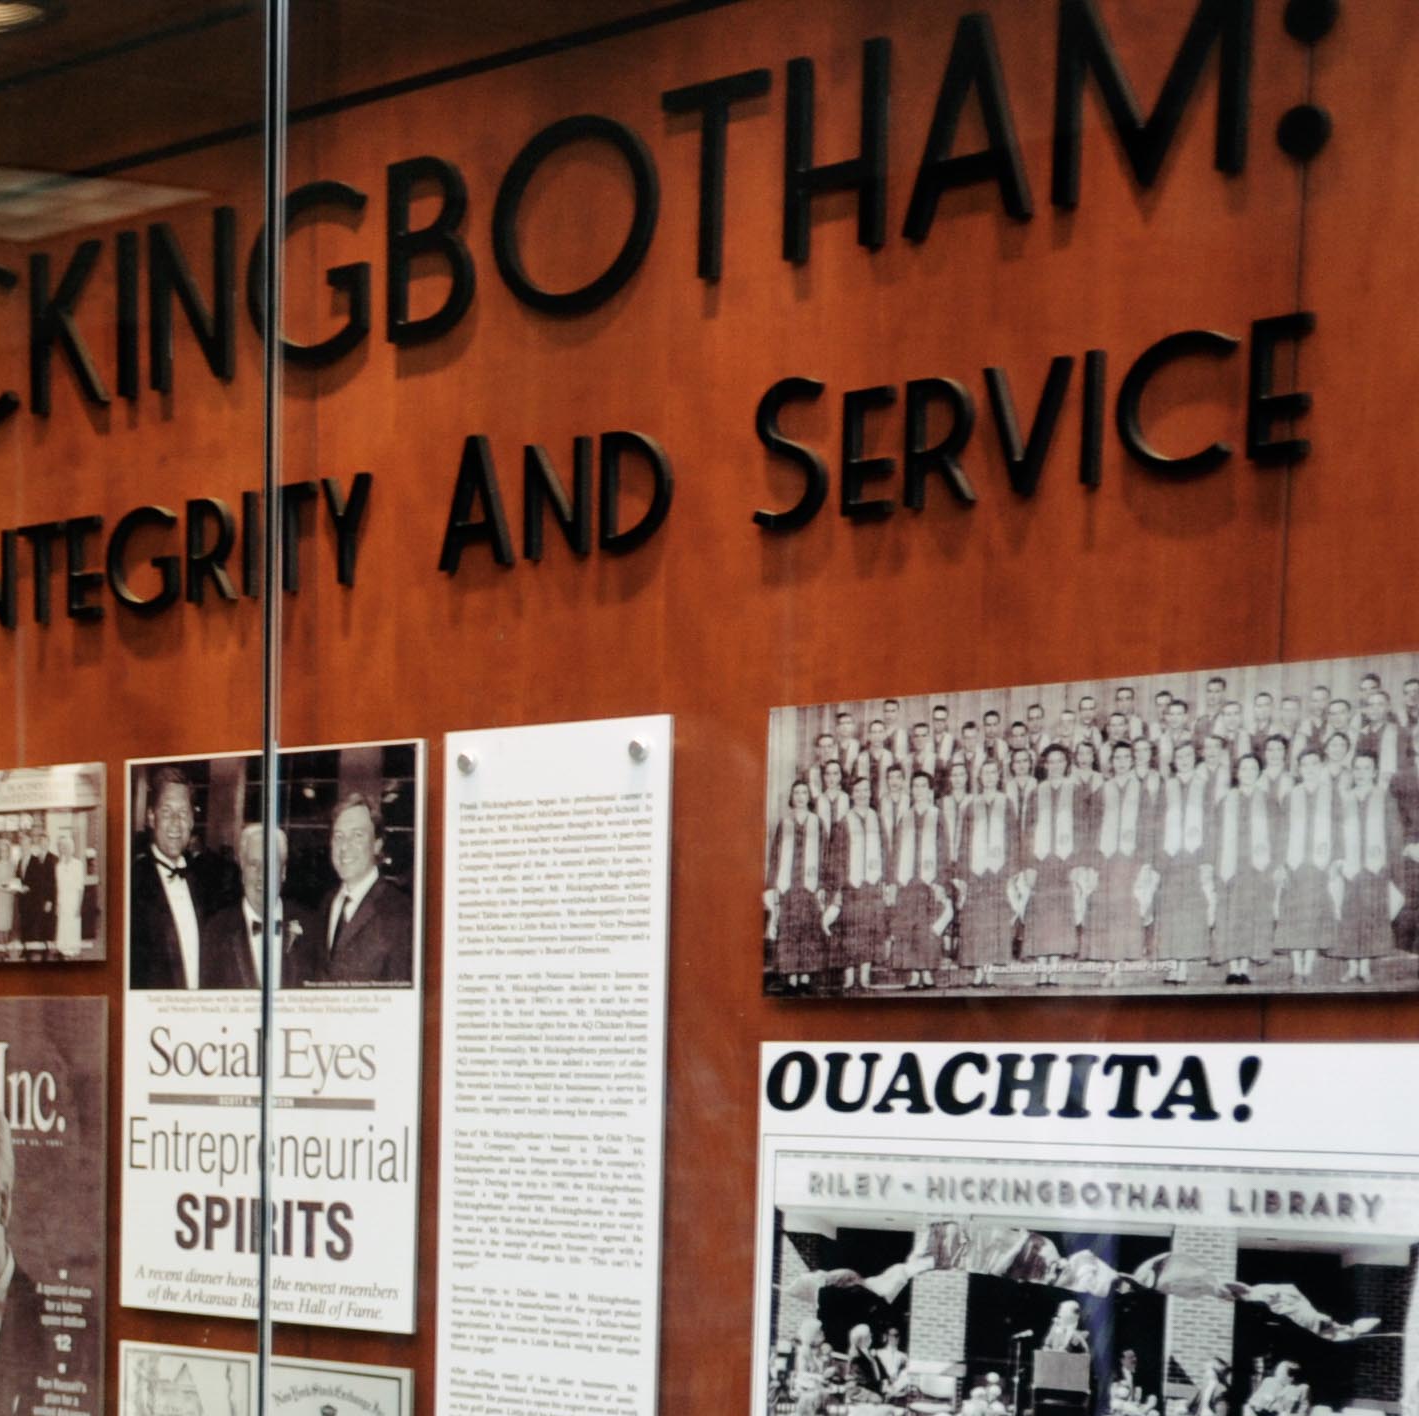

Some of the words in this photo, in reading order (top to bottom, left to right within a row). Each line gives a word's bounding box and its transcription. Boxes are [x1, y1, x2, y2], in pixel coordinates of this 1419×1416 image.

[438, 430, 674, 574] AND
[753, 312, 1316, 533] SERVICE
[148, 1024, 263, 1080] Social
[279, 1027, 377, 1096] Eyes
[766, 1050, 1262, 1123] OUACHITA!
[174, 1192, 355, 1262] SPIRITS
[809, 1171, 892, 1198] RILEY
[926, 1175, 1203, 1213] HICKINGBOTHAM
[1229, 1188, 1385, 1219] LIBRARY
[134, 1265, 146, 1279] A
[146, 1267, 183, 1283] recent
[184, 1268, 224, 1287] dinner
[271, 1276, 291, 1292] the
[294, 1280, 337, 1297] newest
[339, 1283, 400, 1301] members
[146, 1284, 161, 1301] of
[162, 1286, 180, 1301] the
[182, 1287, 238, 1308] Arkansas
[241, 1291, 295, 1313] Buness
[298, 1297, 326, 1316] Hall
[327, 1299, 344, 1319] of
[346, 1301, 384, 1321] Fame.
